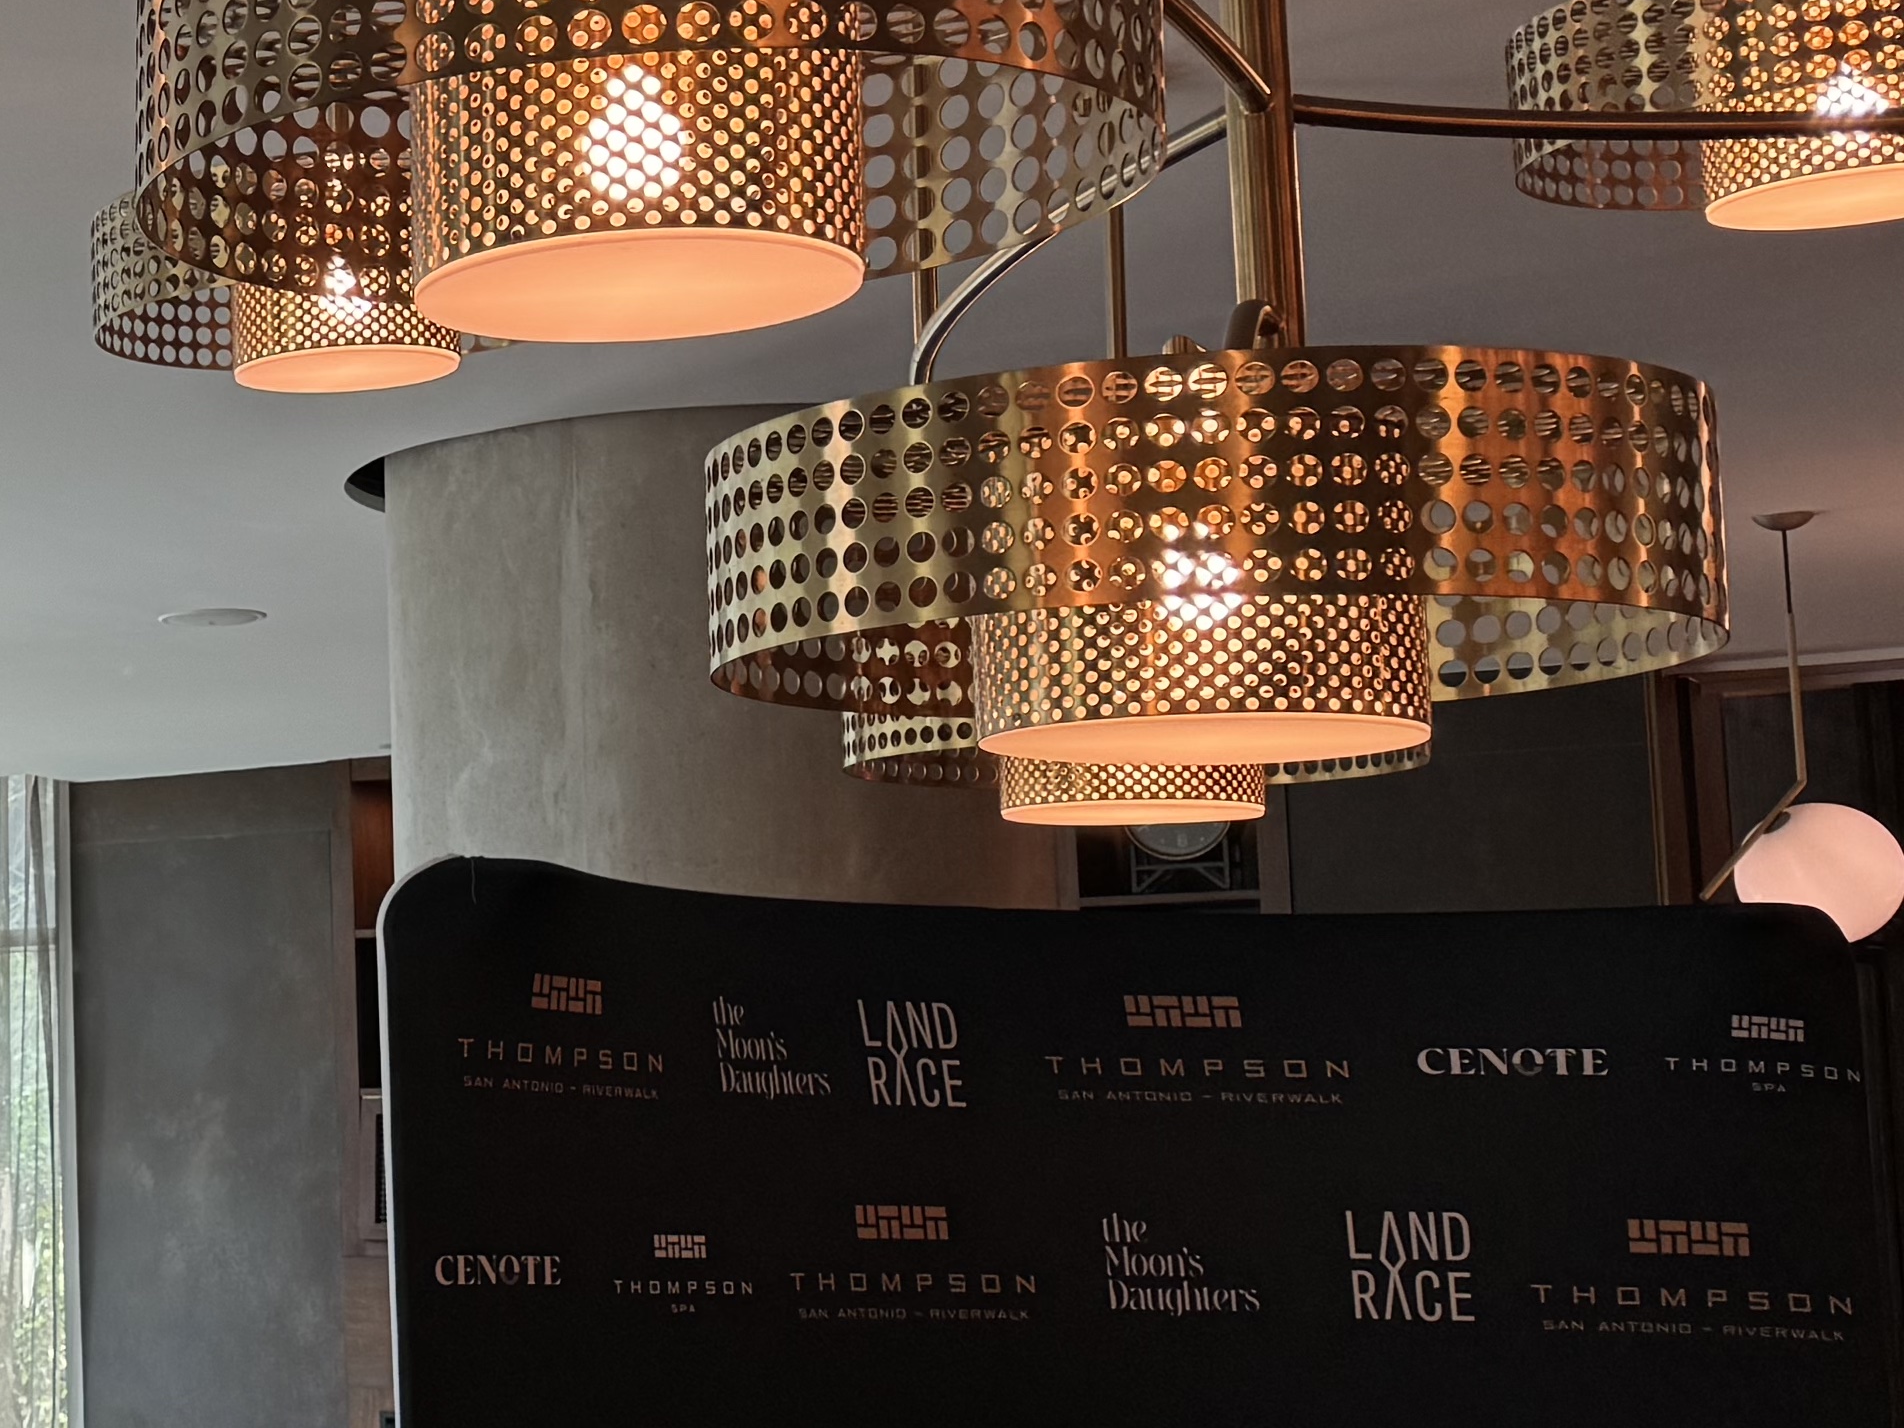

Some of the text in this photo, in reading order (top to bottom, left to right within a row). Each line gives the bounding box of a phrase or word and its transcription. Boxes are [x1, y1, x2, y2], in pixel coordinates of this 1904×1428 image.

[713, 996, 744, 1027] the
[857, 999, 958, 1050] LAND
[458, 1038, 664, 1073] THOMPSON
[717, 1030, 788, 1061] Moon's
[1416, 1047, 1610, 1076] CENOTE
[720, 1063, 831, 1099] Daughters
[869, 1055, 967, 1108] RACE
[1044, 1056, 1351, 1078] THOMPSON
[1666, 1057, 1861, 1083] THOMPSON
[1752, 1082, 1786, 1093] SPA
[1102, 1213, 1147, 1245] the
[1345, 1210, 1471, 1262] LAND
[434, 1254, 561, 1287] CENOTE
[1104, 1245, 1205, 1278] Moon's
[613, 1280, 754, 1296] THOMPSON
[790, 1273, 1036, 1293] THOMPSON
[1108, 1280, 1260, 1317] Daughters
[1352, 1271, 1476, 1322] RACE
[1530, 1284, 1853, 1315] THOMPSON
